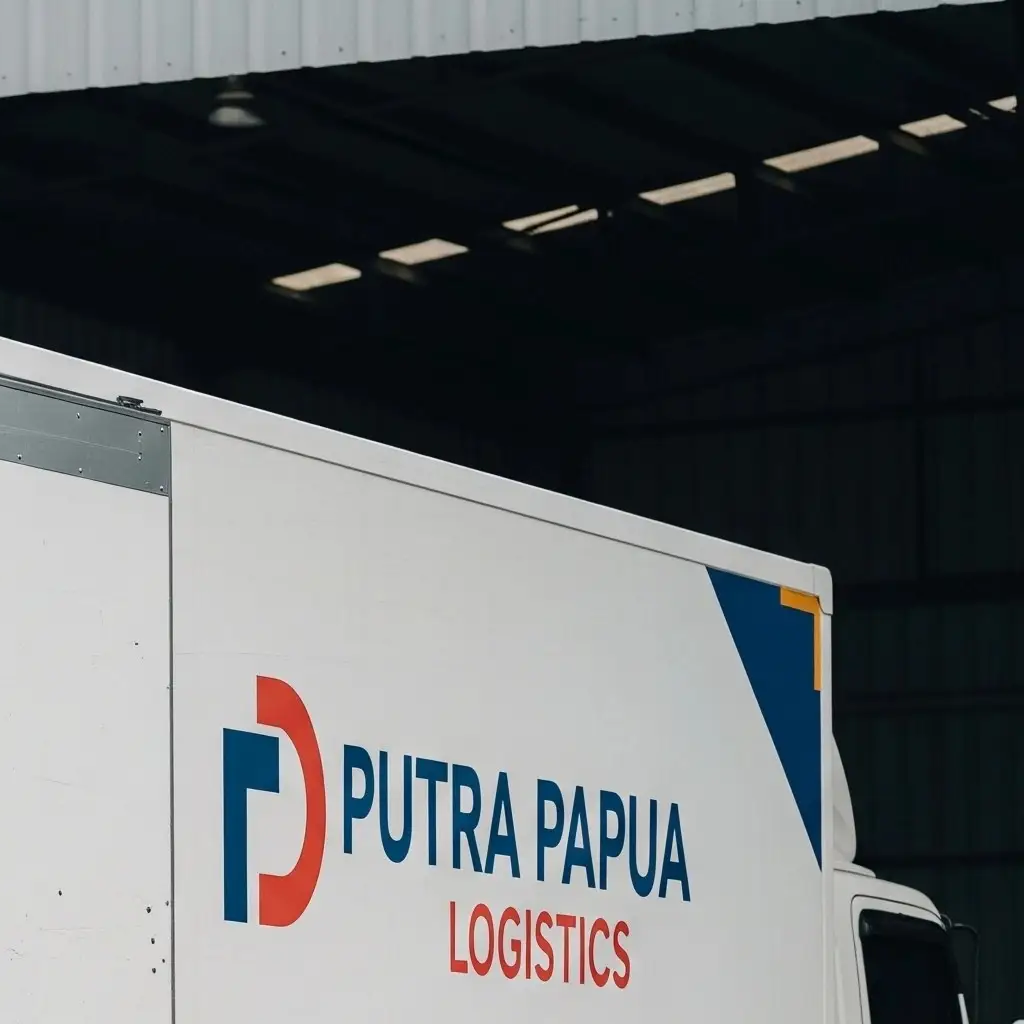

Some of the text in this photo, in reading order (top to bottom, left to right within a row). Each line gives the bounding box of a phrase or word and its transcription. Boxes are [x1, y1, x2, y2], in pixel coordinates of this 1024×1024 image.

[343, 744, 691, 901] PUTRA PAPUA
[450, 901, 630, 989] LOGISTICS
